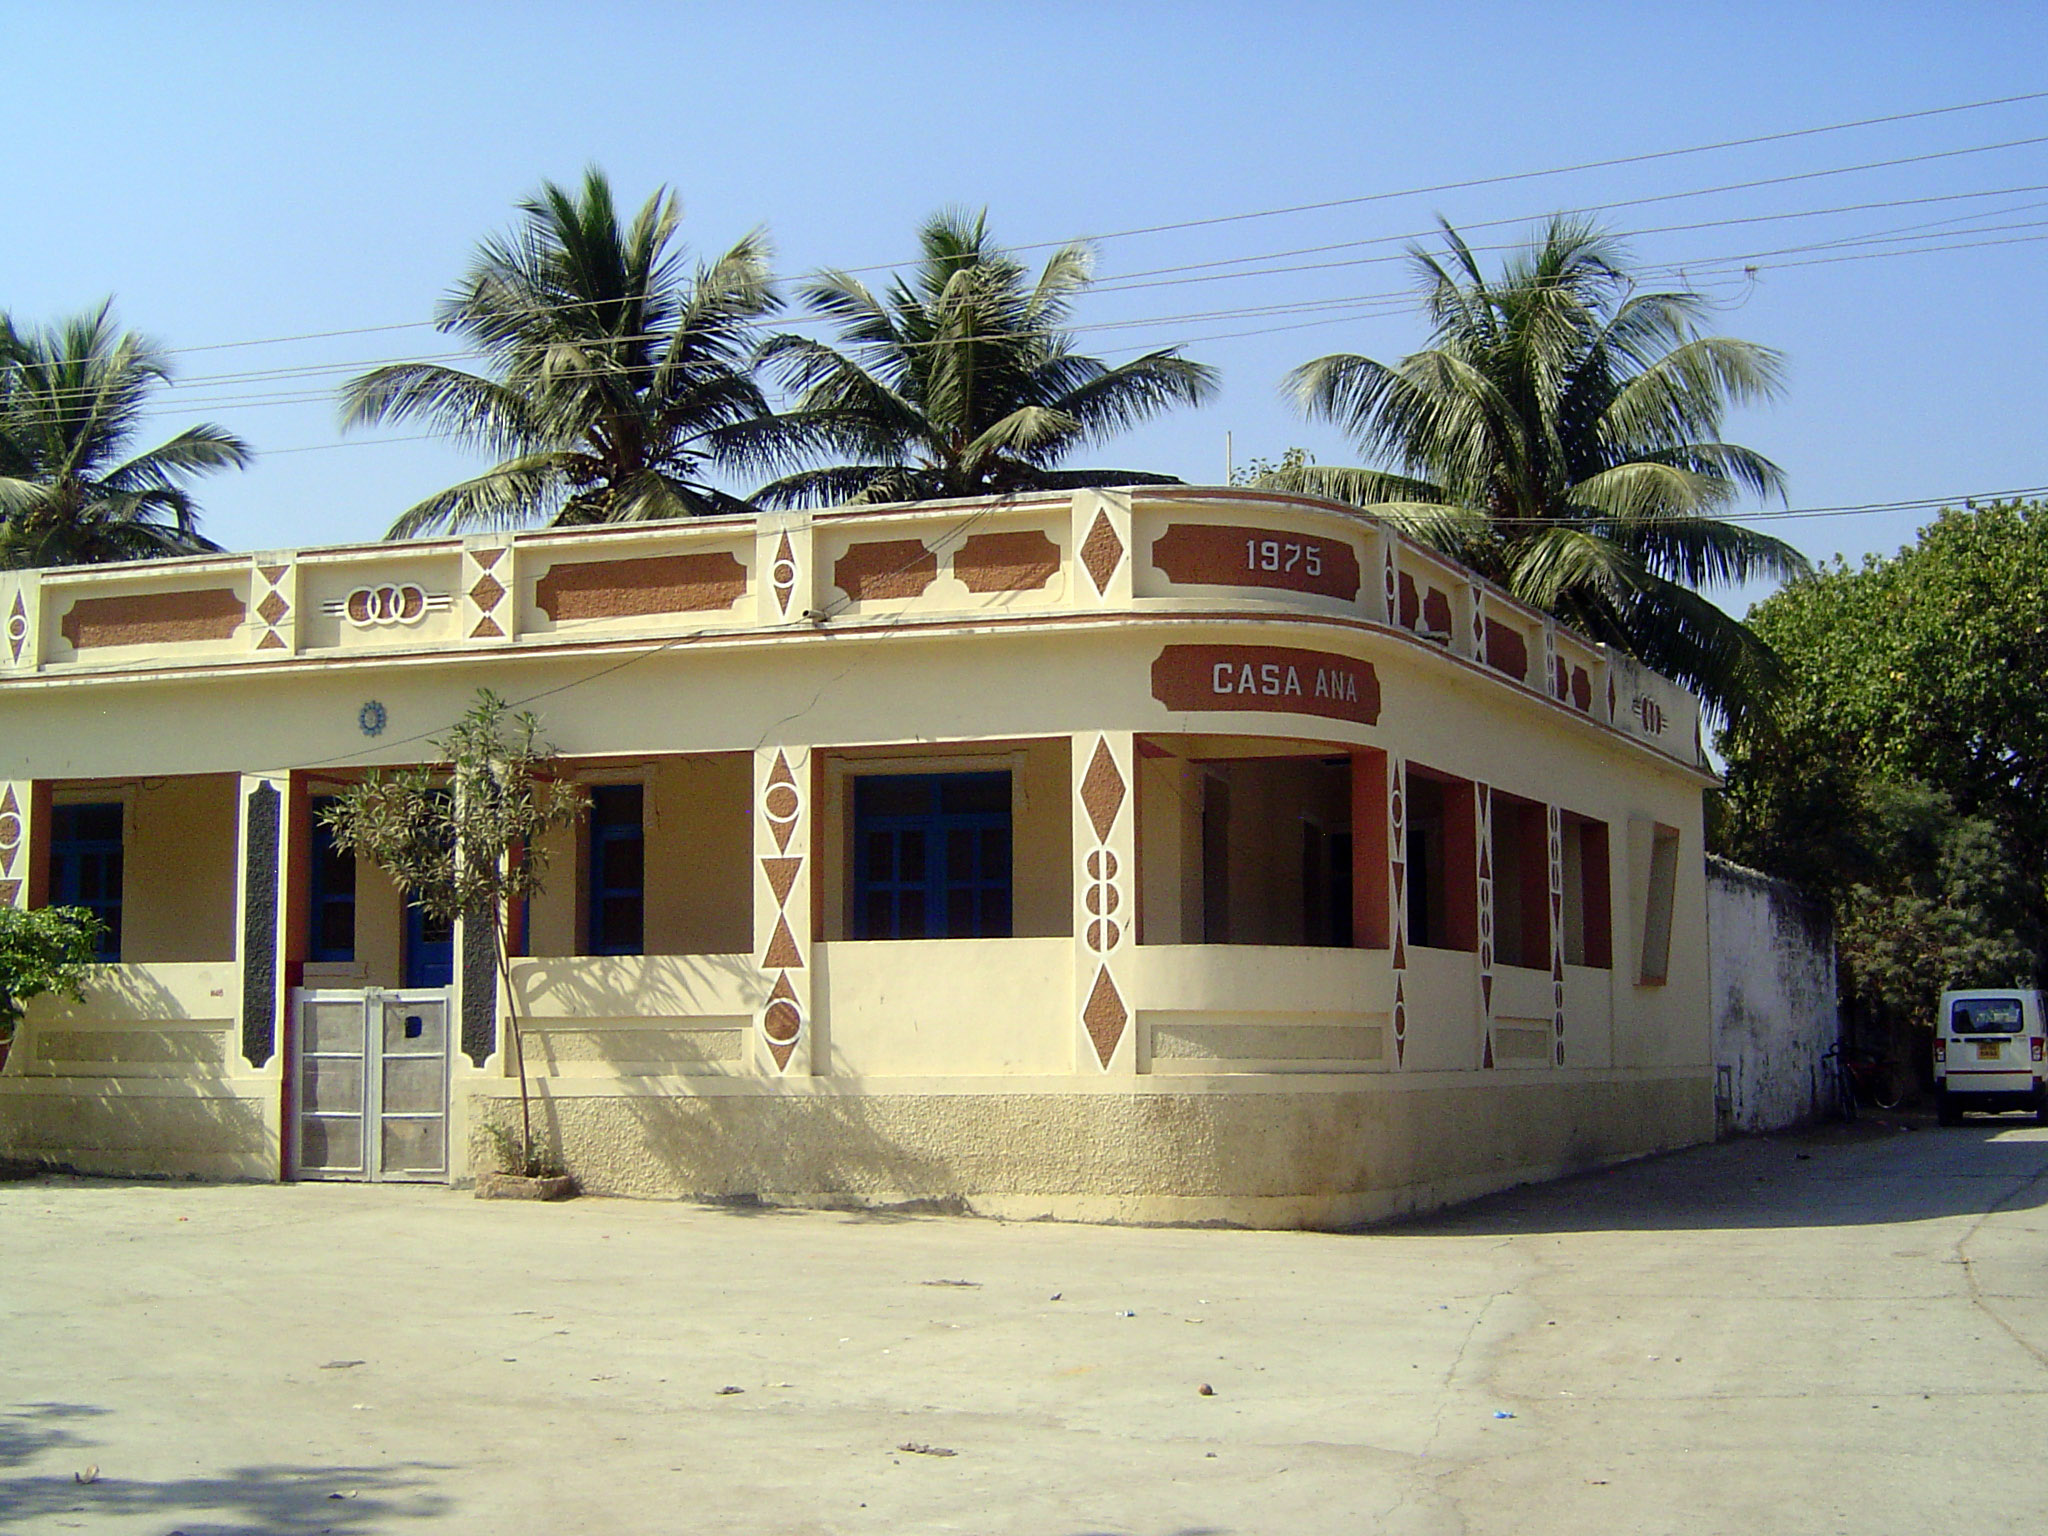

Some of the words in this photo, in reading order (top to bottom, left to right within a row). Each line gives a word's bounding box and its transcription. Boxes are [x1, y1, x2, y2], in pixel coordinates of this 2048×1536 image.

[1246, 540, 1321, 576] 1975
[1213, 663, 1301, 695] CASA
[1315, 669, 1357, 702] ANA
